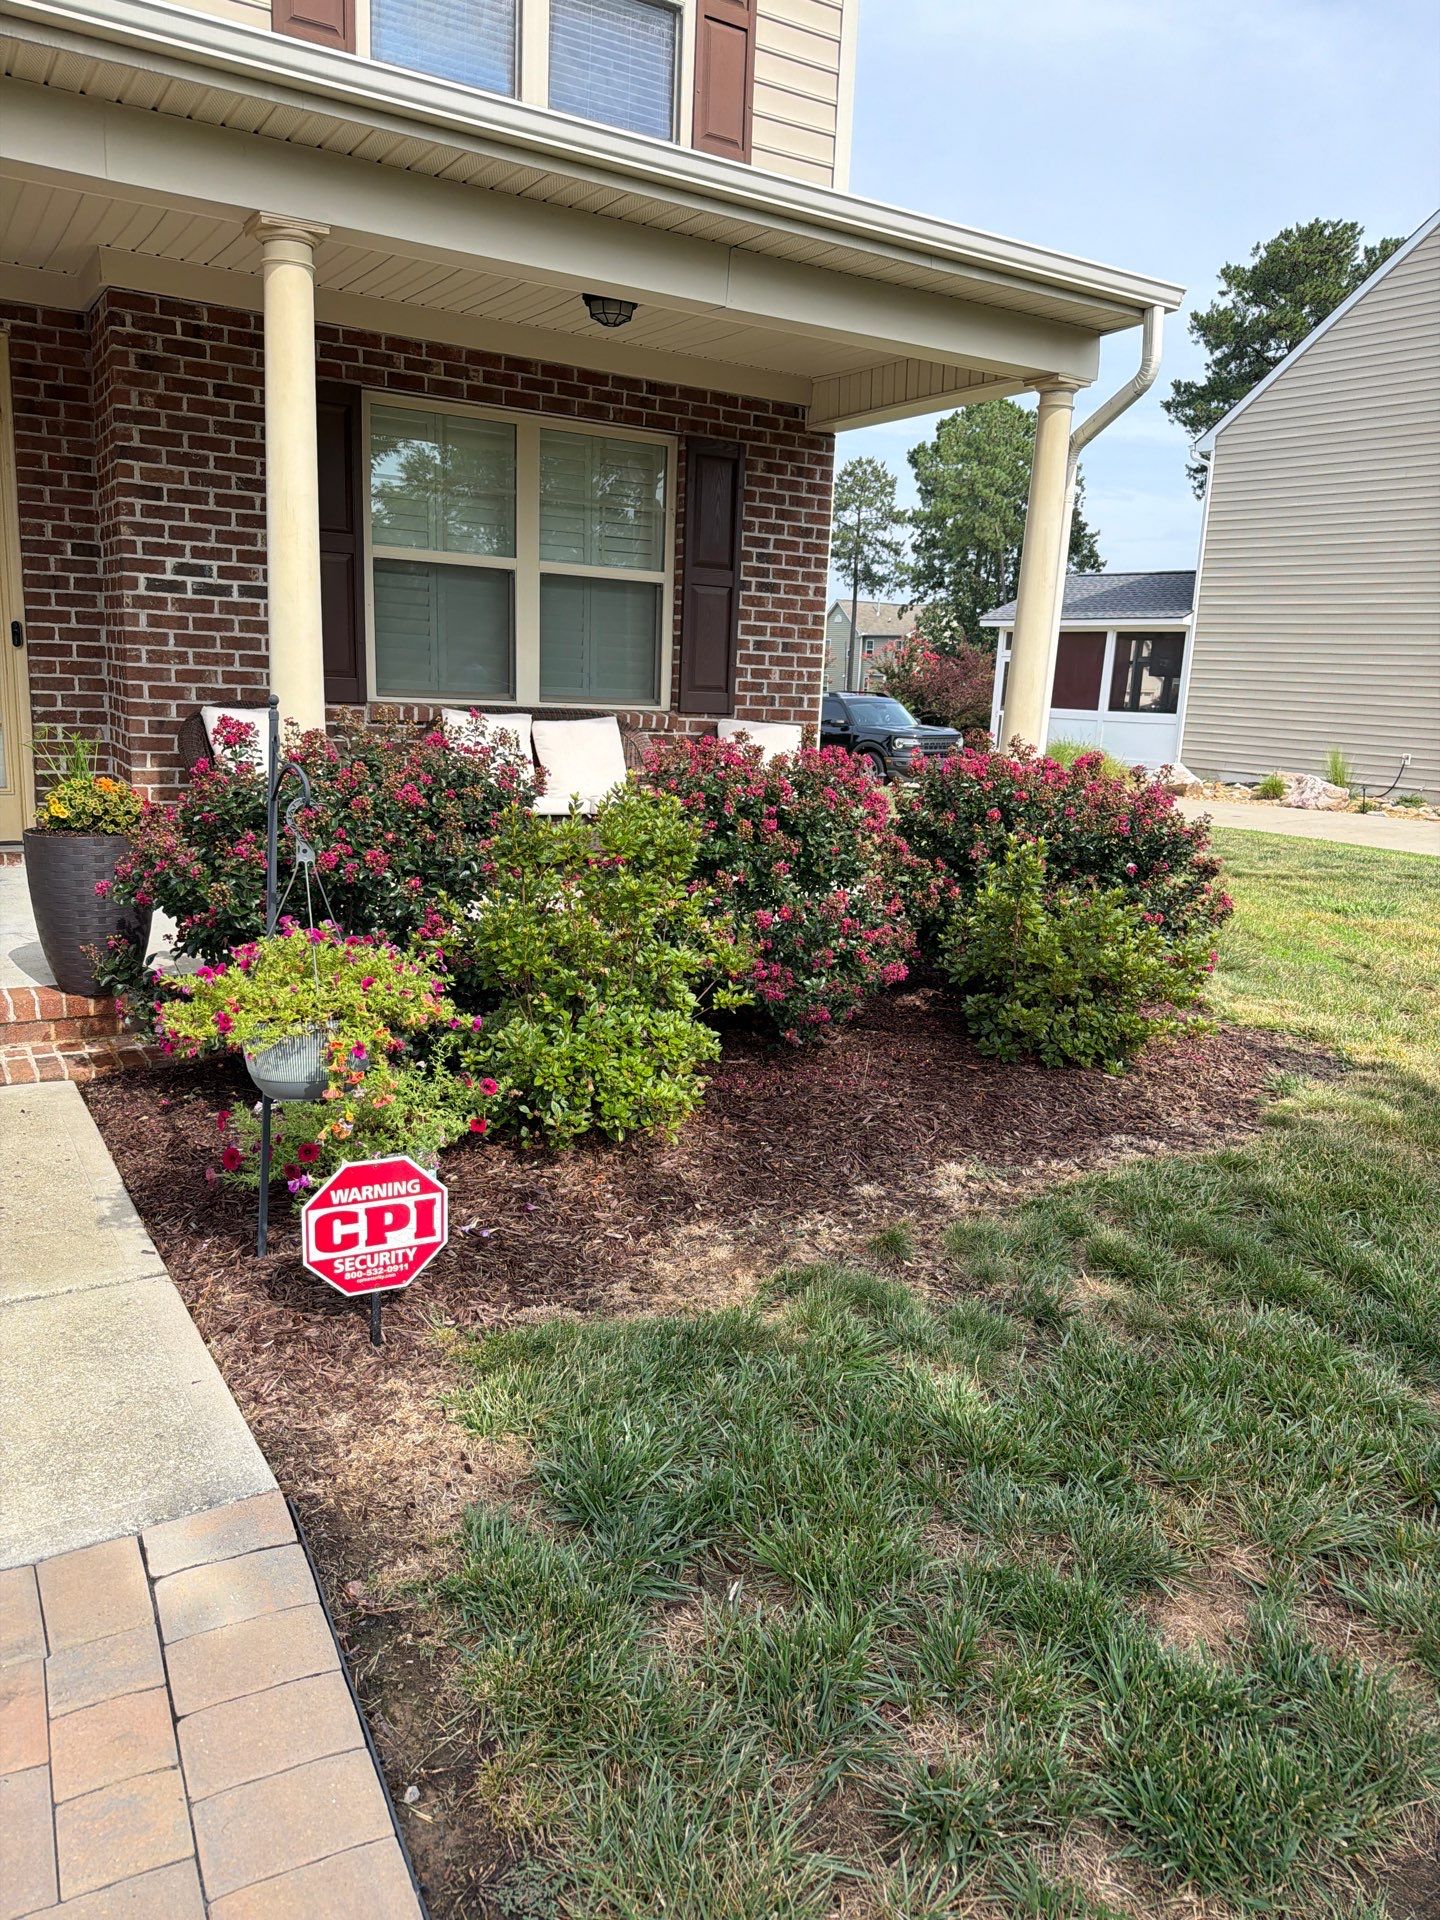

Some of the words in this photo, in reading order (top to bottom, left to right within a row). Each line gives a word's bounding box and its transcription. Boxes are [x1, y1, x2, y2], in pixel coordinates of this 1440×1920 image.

[330, 1179, 420, 1205] WARNING
[315, 1198, 436, 1253] CPI
[333, 1247, 417, 1274] SECURITY
[344, 1263, 409, 1280] 800-532-0911
